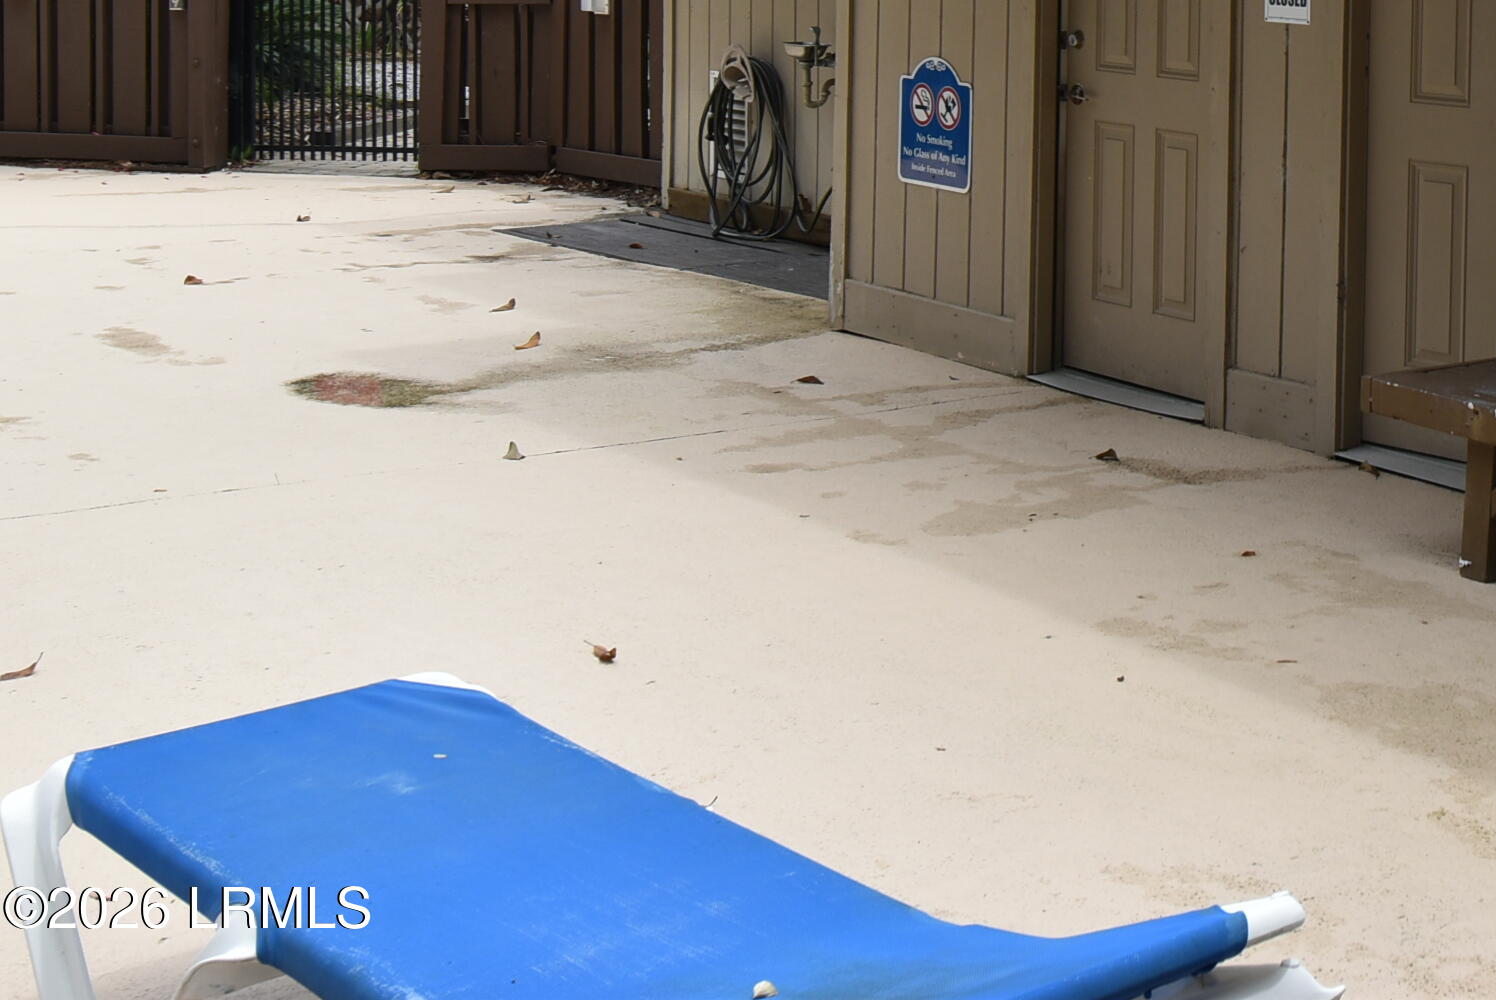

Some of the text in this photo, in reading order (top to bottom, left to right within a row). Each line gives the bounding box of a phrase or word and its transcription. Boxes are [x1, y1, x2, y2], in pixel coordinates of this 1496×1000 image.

[916, 132, 953, 150] No Smoking
[903, 146, 967, 166] No Glass of Any Kind
